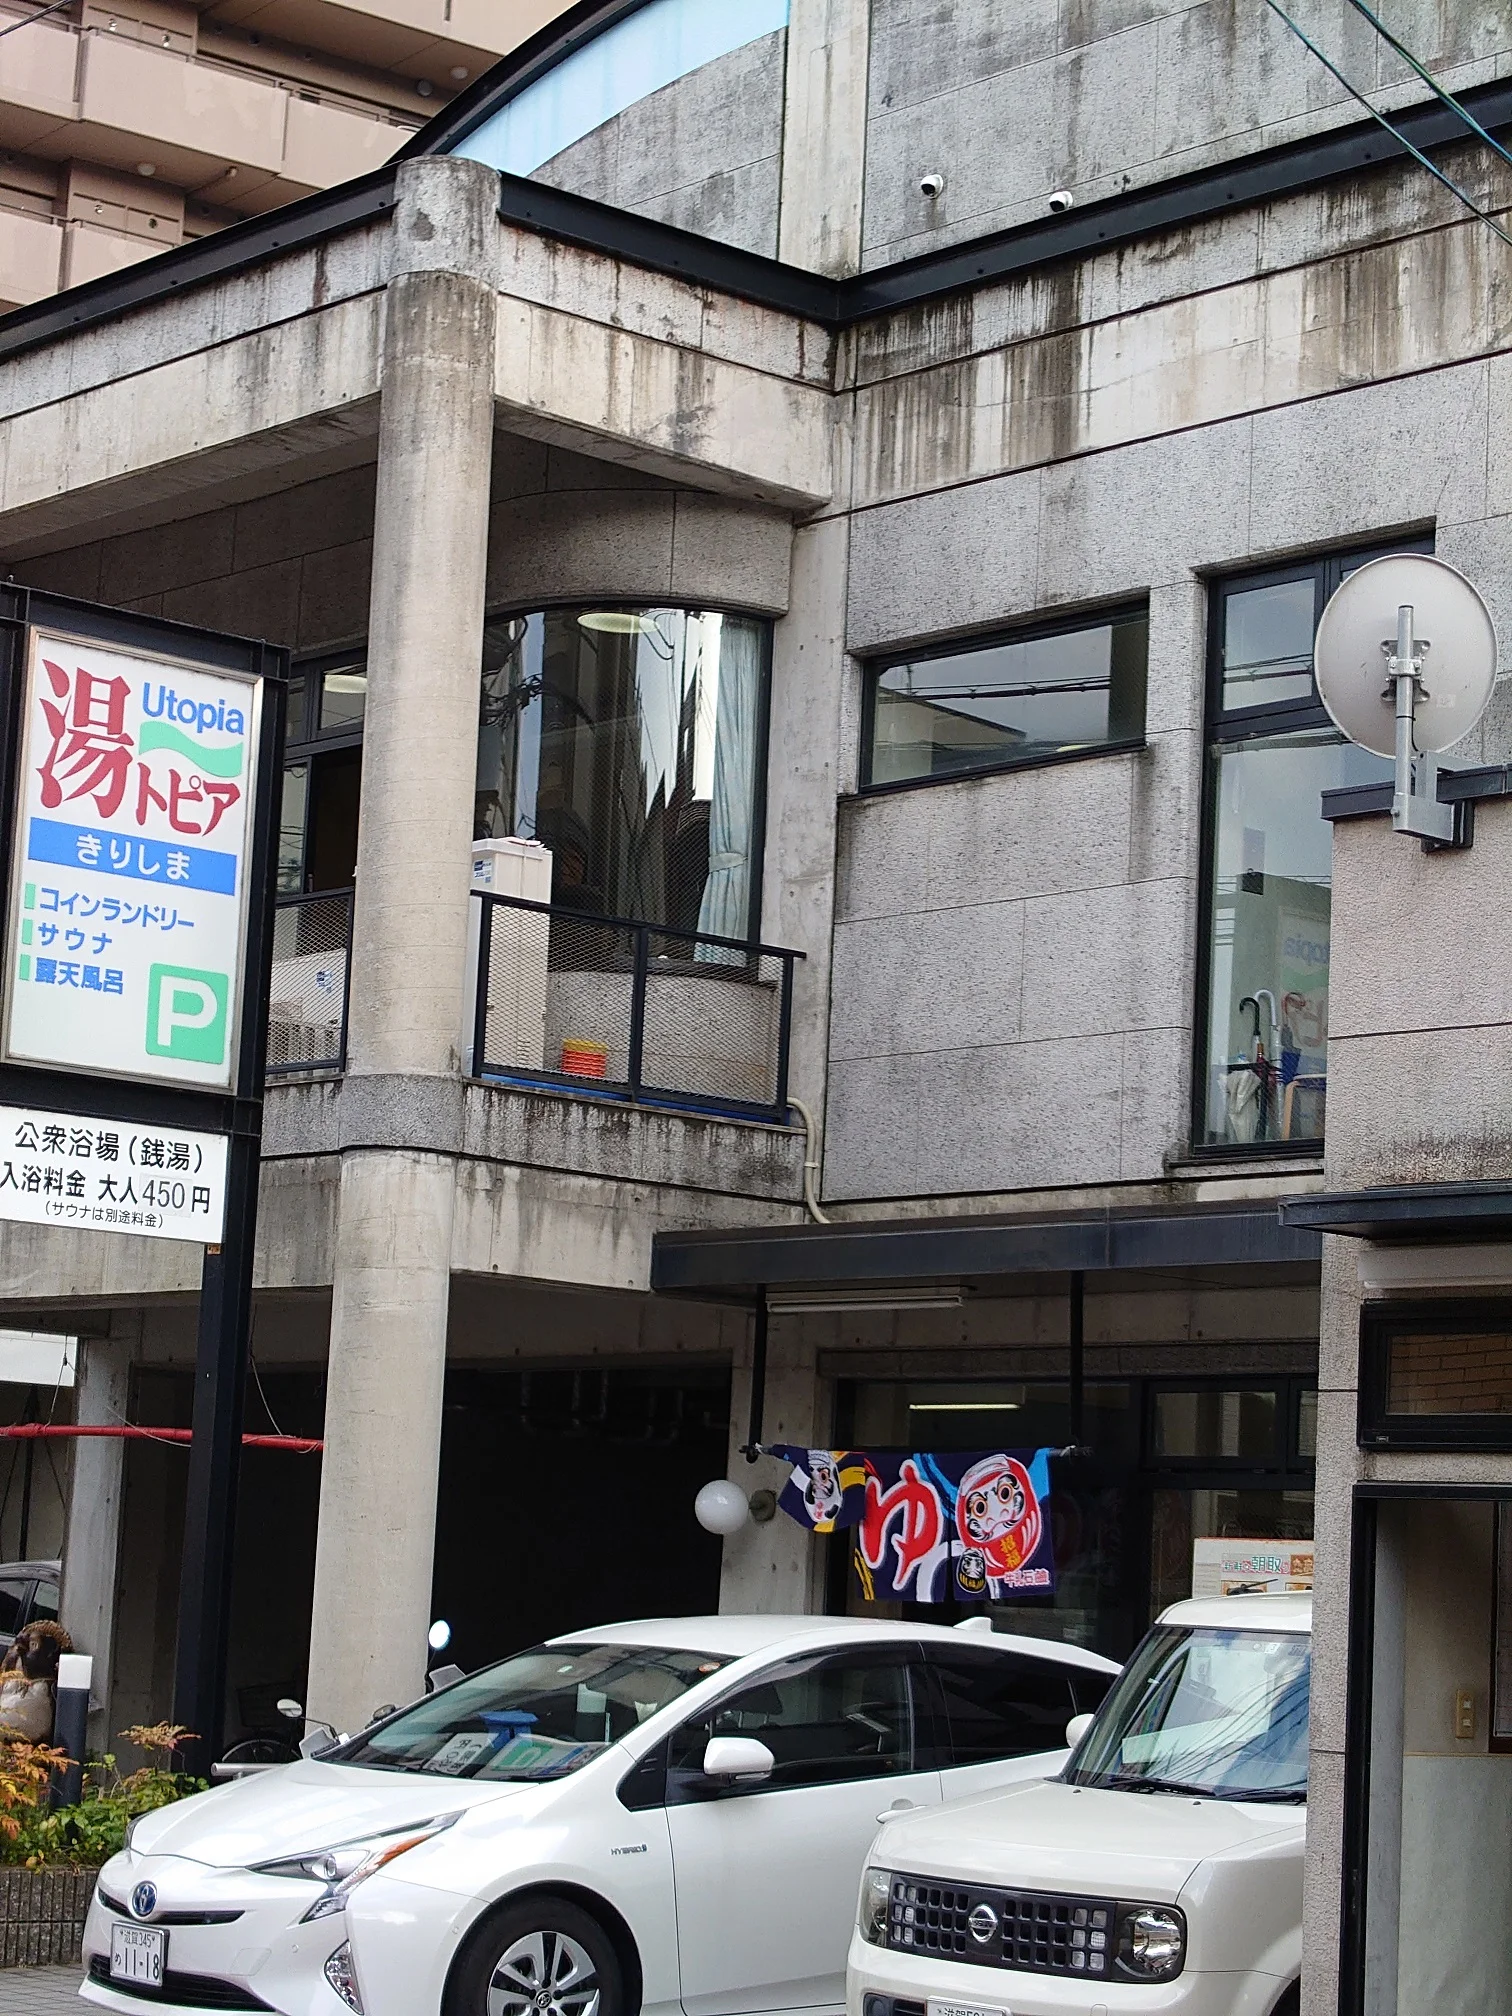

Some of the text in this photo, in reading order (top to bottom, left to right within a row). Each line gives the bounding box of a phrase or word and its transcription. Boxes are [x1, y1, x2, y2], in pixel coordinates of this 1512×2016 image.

[142, 682, 245, 735] Utopia
[76, 833, 191, 881] きりしま
[40, 887, 195, 931] コインランドリー
[38, 922, 113, 955] サウナ
[35, 957, 124, 995] 露天風呂
[157, 974, 218, 1048] P
[0, 1161, 211, 1214] 入浴料金 大人450円
[45, 1200, 164, 1229] （サウナは別途料金）
[860, 1459, 944, 1590] ゆ
